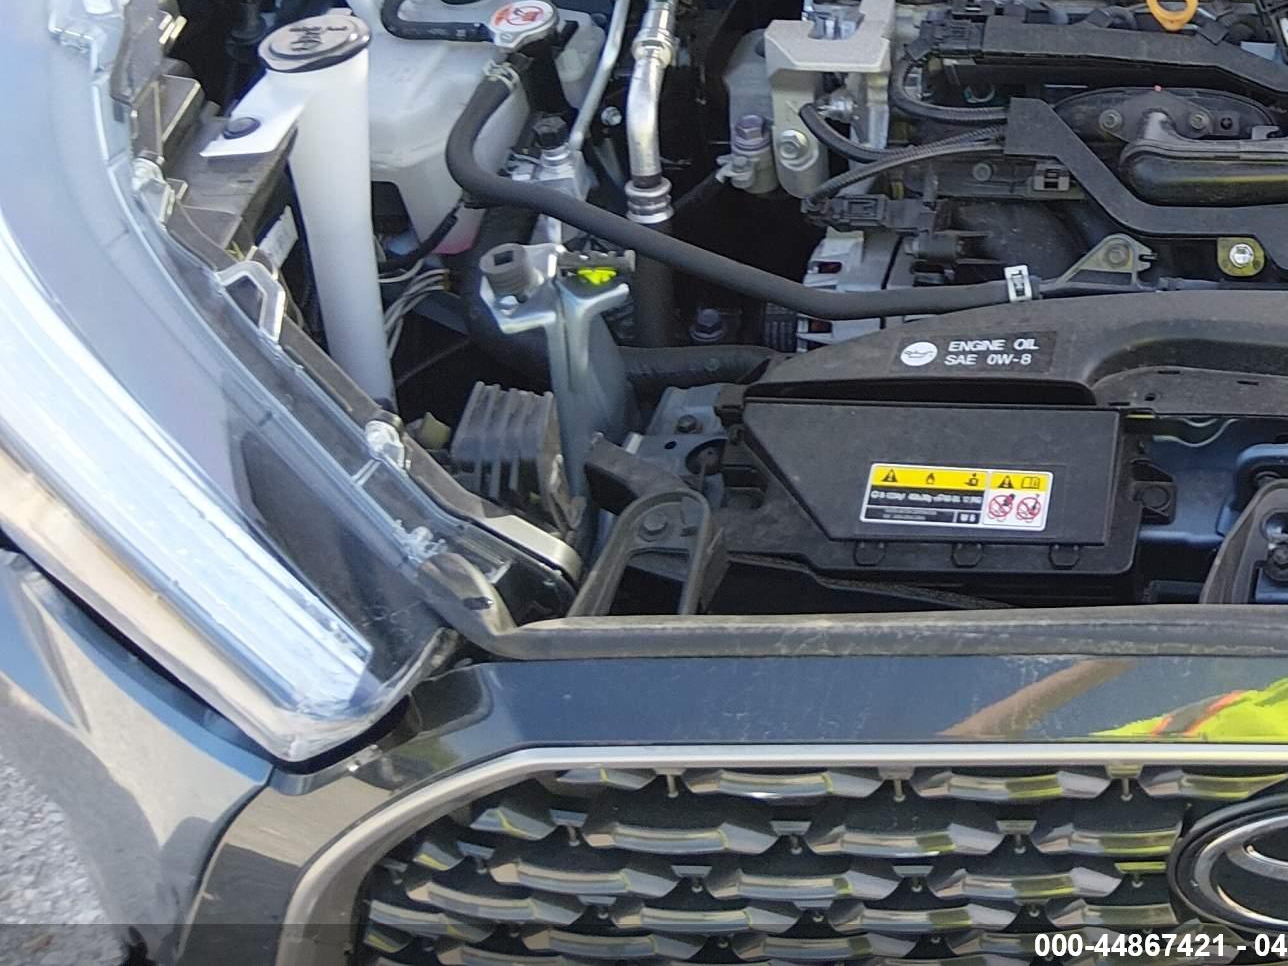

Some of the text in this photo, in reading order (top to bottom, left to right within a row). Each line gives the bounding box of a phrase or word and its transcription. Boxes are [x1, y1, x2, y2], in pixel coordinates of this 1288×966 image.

[947, 337, 1040, 352] ENGINE OIL
[943, 353, 979, 366] SAE
